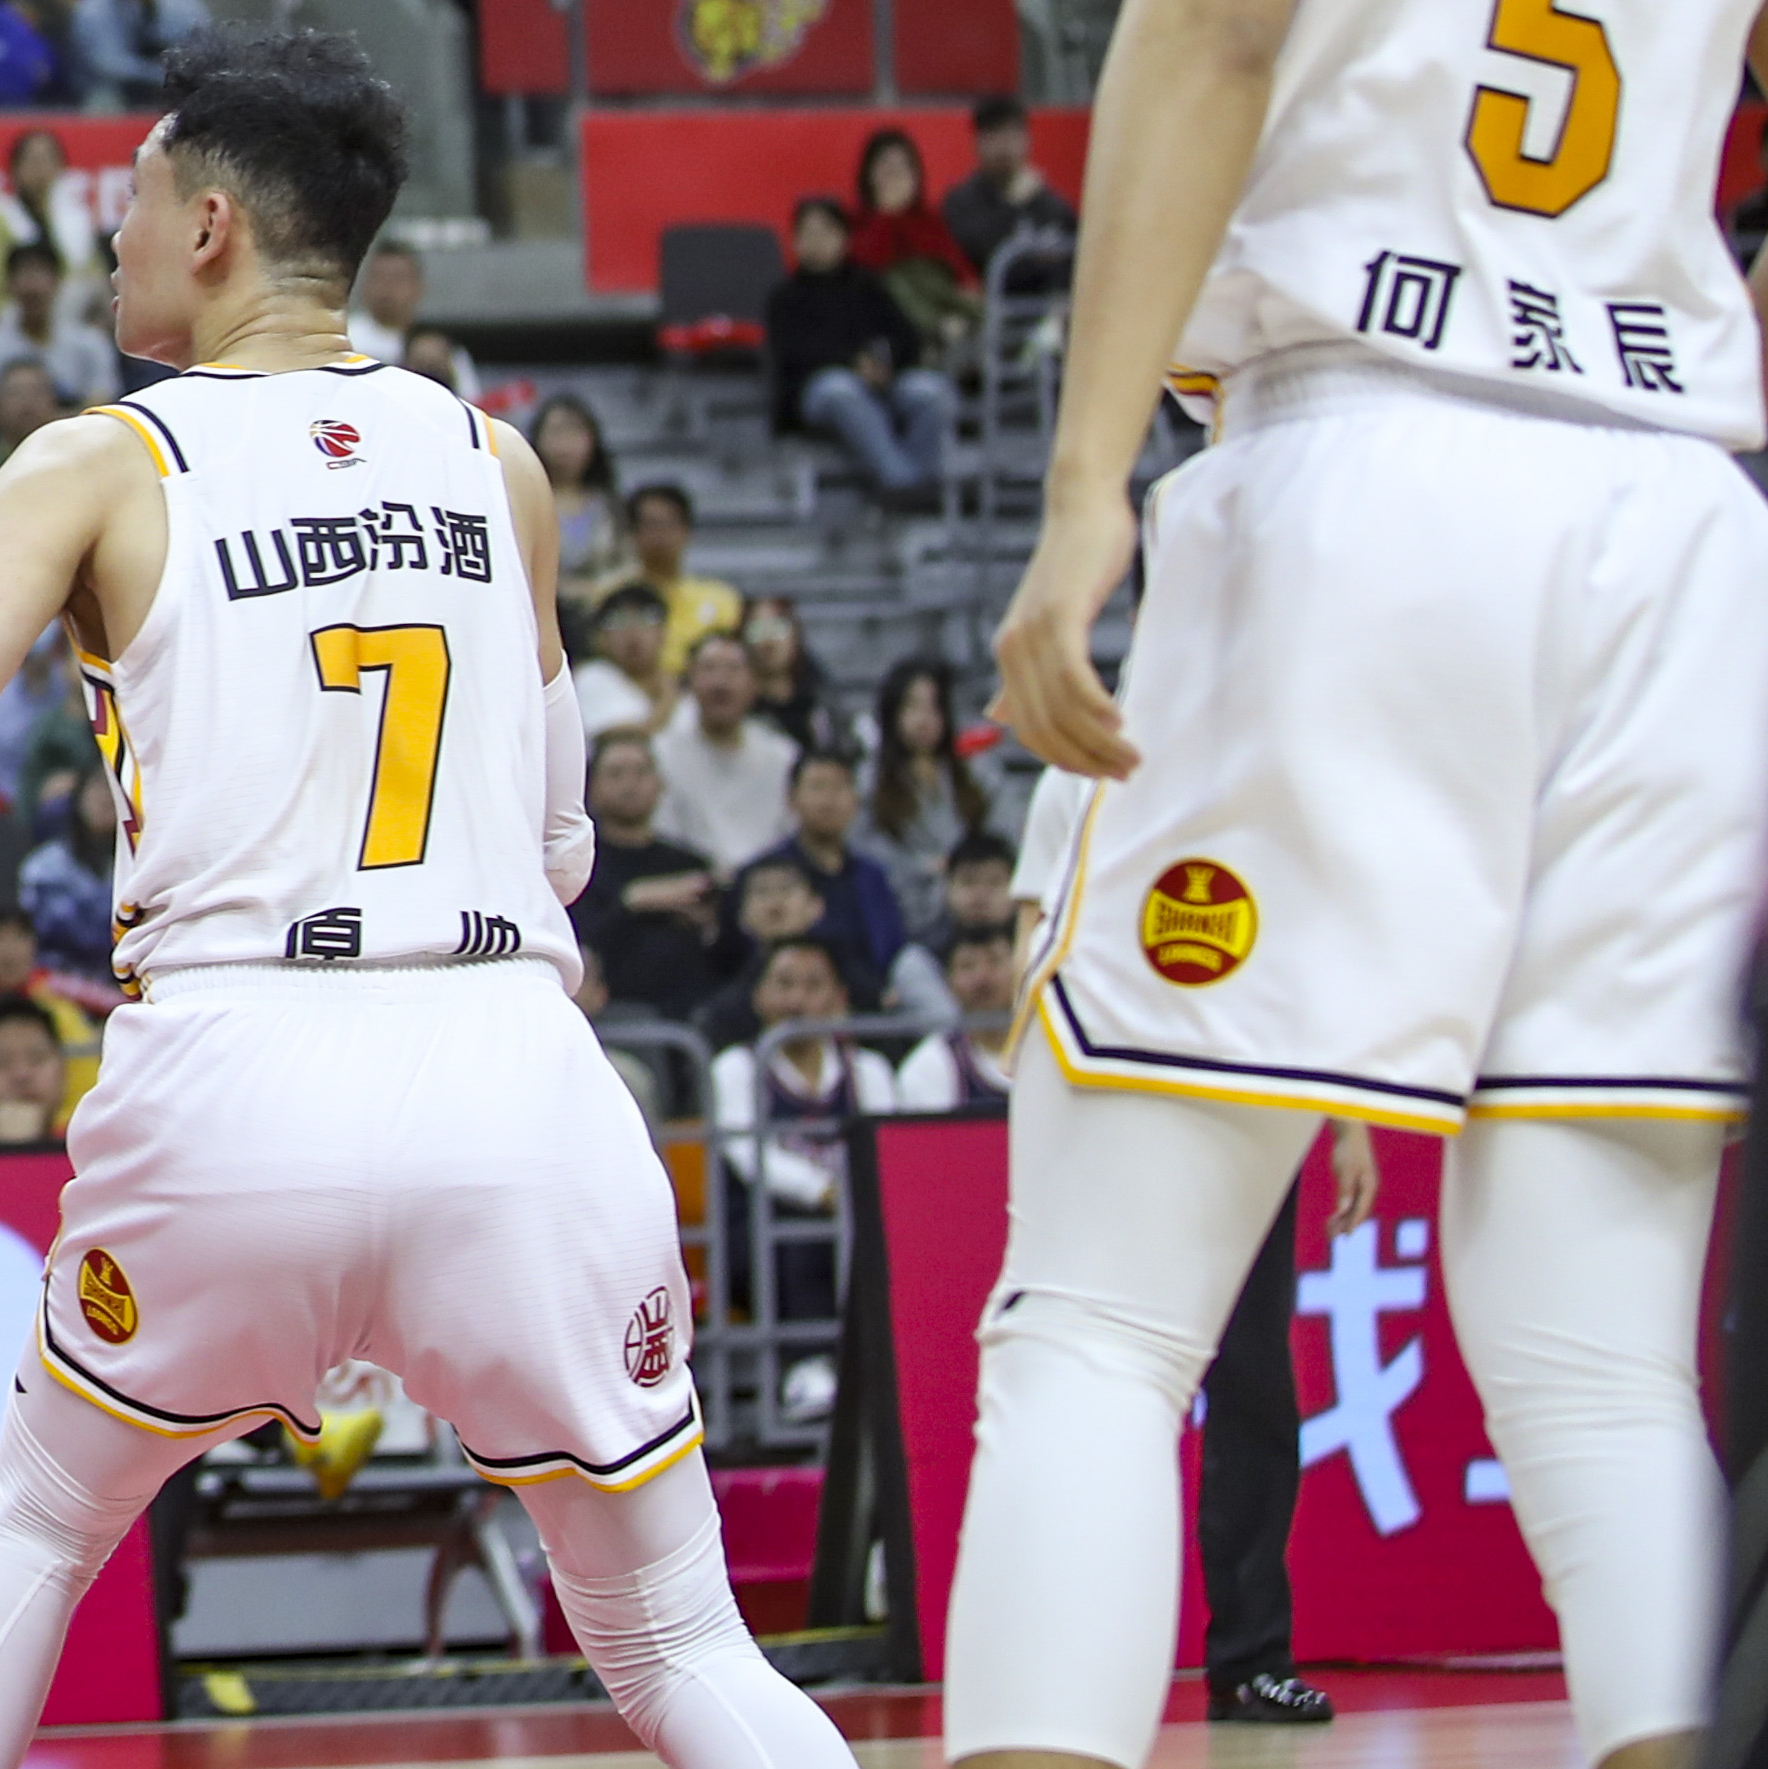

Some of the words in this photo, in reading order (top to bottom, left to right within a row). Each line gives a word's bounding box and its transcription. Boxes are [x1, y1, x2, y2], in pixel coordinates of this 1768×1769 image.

[214, 500, 492, 602] 山西汾酒
[309, 622, 451, 872] 7
